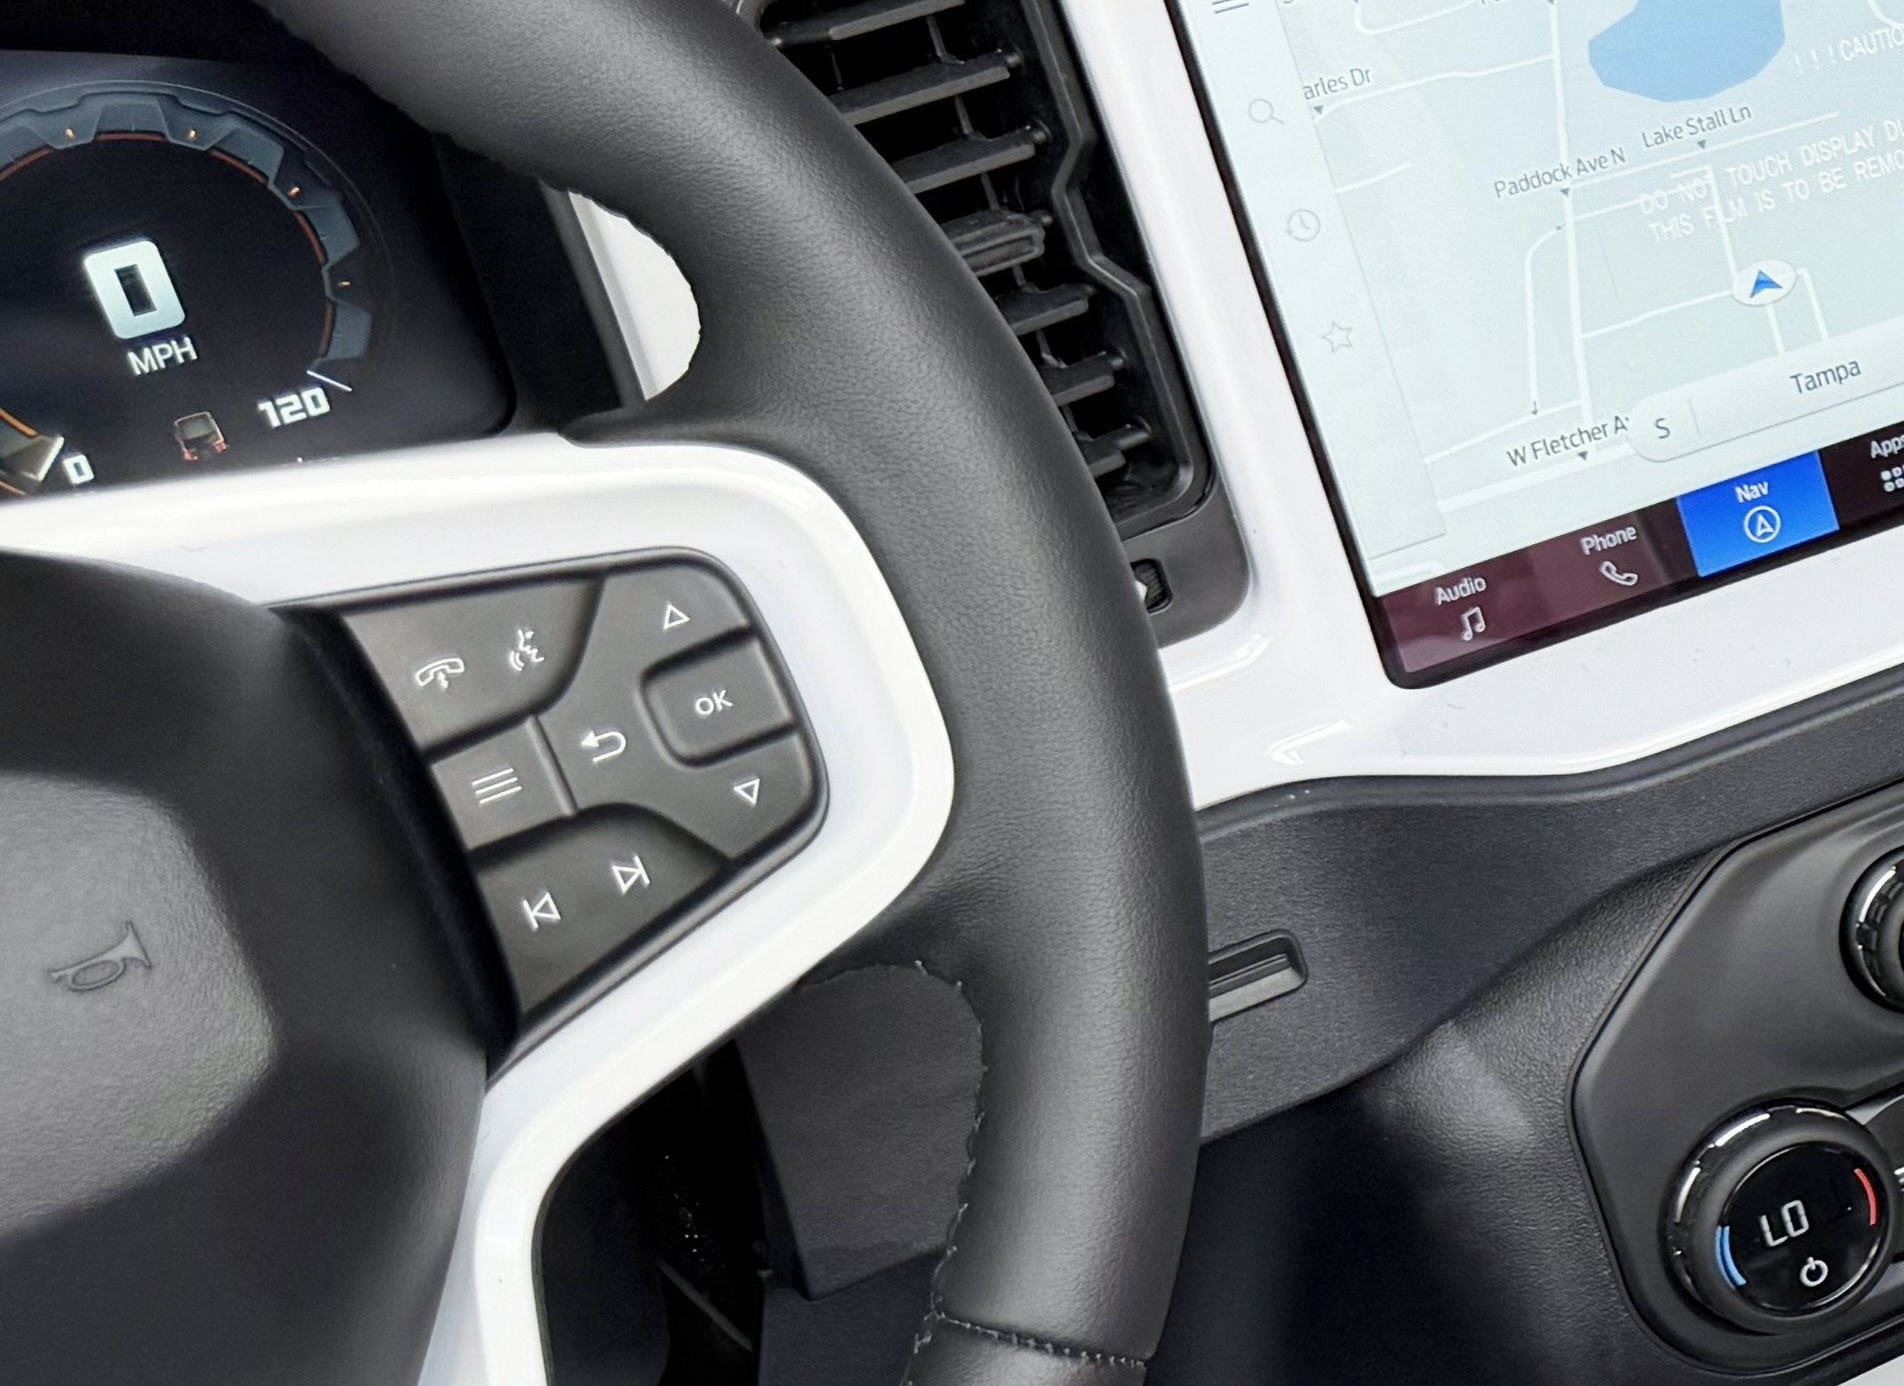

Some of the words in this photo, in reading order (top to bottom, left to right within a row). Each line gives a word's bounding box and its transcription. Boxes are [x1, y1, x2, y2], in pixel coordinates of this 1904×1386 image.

[1350, 68, 1371, 86] Dr
[1642, 123, 1684, 149] Lake
[1686, 110, 1727, 135] Stall
[1729, 105, 1752, 123] Ln
[1494, 164, 1573, 198] Paddock
[1576, 157, 1608, 177] Ave
[1609, 147, 1626, 165] N
[1638, 189, 1669, 215] DO
[1726, 152, 1792, 189] TOUCH
[1801, 127, 1875, 167] DISPLAY
[1649, 214, 1695, 245] THIS
[1755, 190, 1776, 212] IS
[1782, 178, 1810, 204] TO
[1818, 168, 1847, 194] BE
[83, 239, 187, 340] 0
[127, 337, 198, 376] MPH
[1790, 359, 1862, 395] Tampa
[258, 386, 332, 428] 120
[1506, 446, 1527, 467] W
[1531, 421, 1610, 460] Fletcher
[1655, 418, 1672, 439] S
[62, 453, 95, 485] 0
[1735, 480, 1769, 503] Nav
[1580, 525, 1637, 555] Phone
[1434, 576, 1487, 605] Audio
[695, 689, 733, 716] OK
